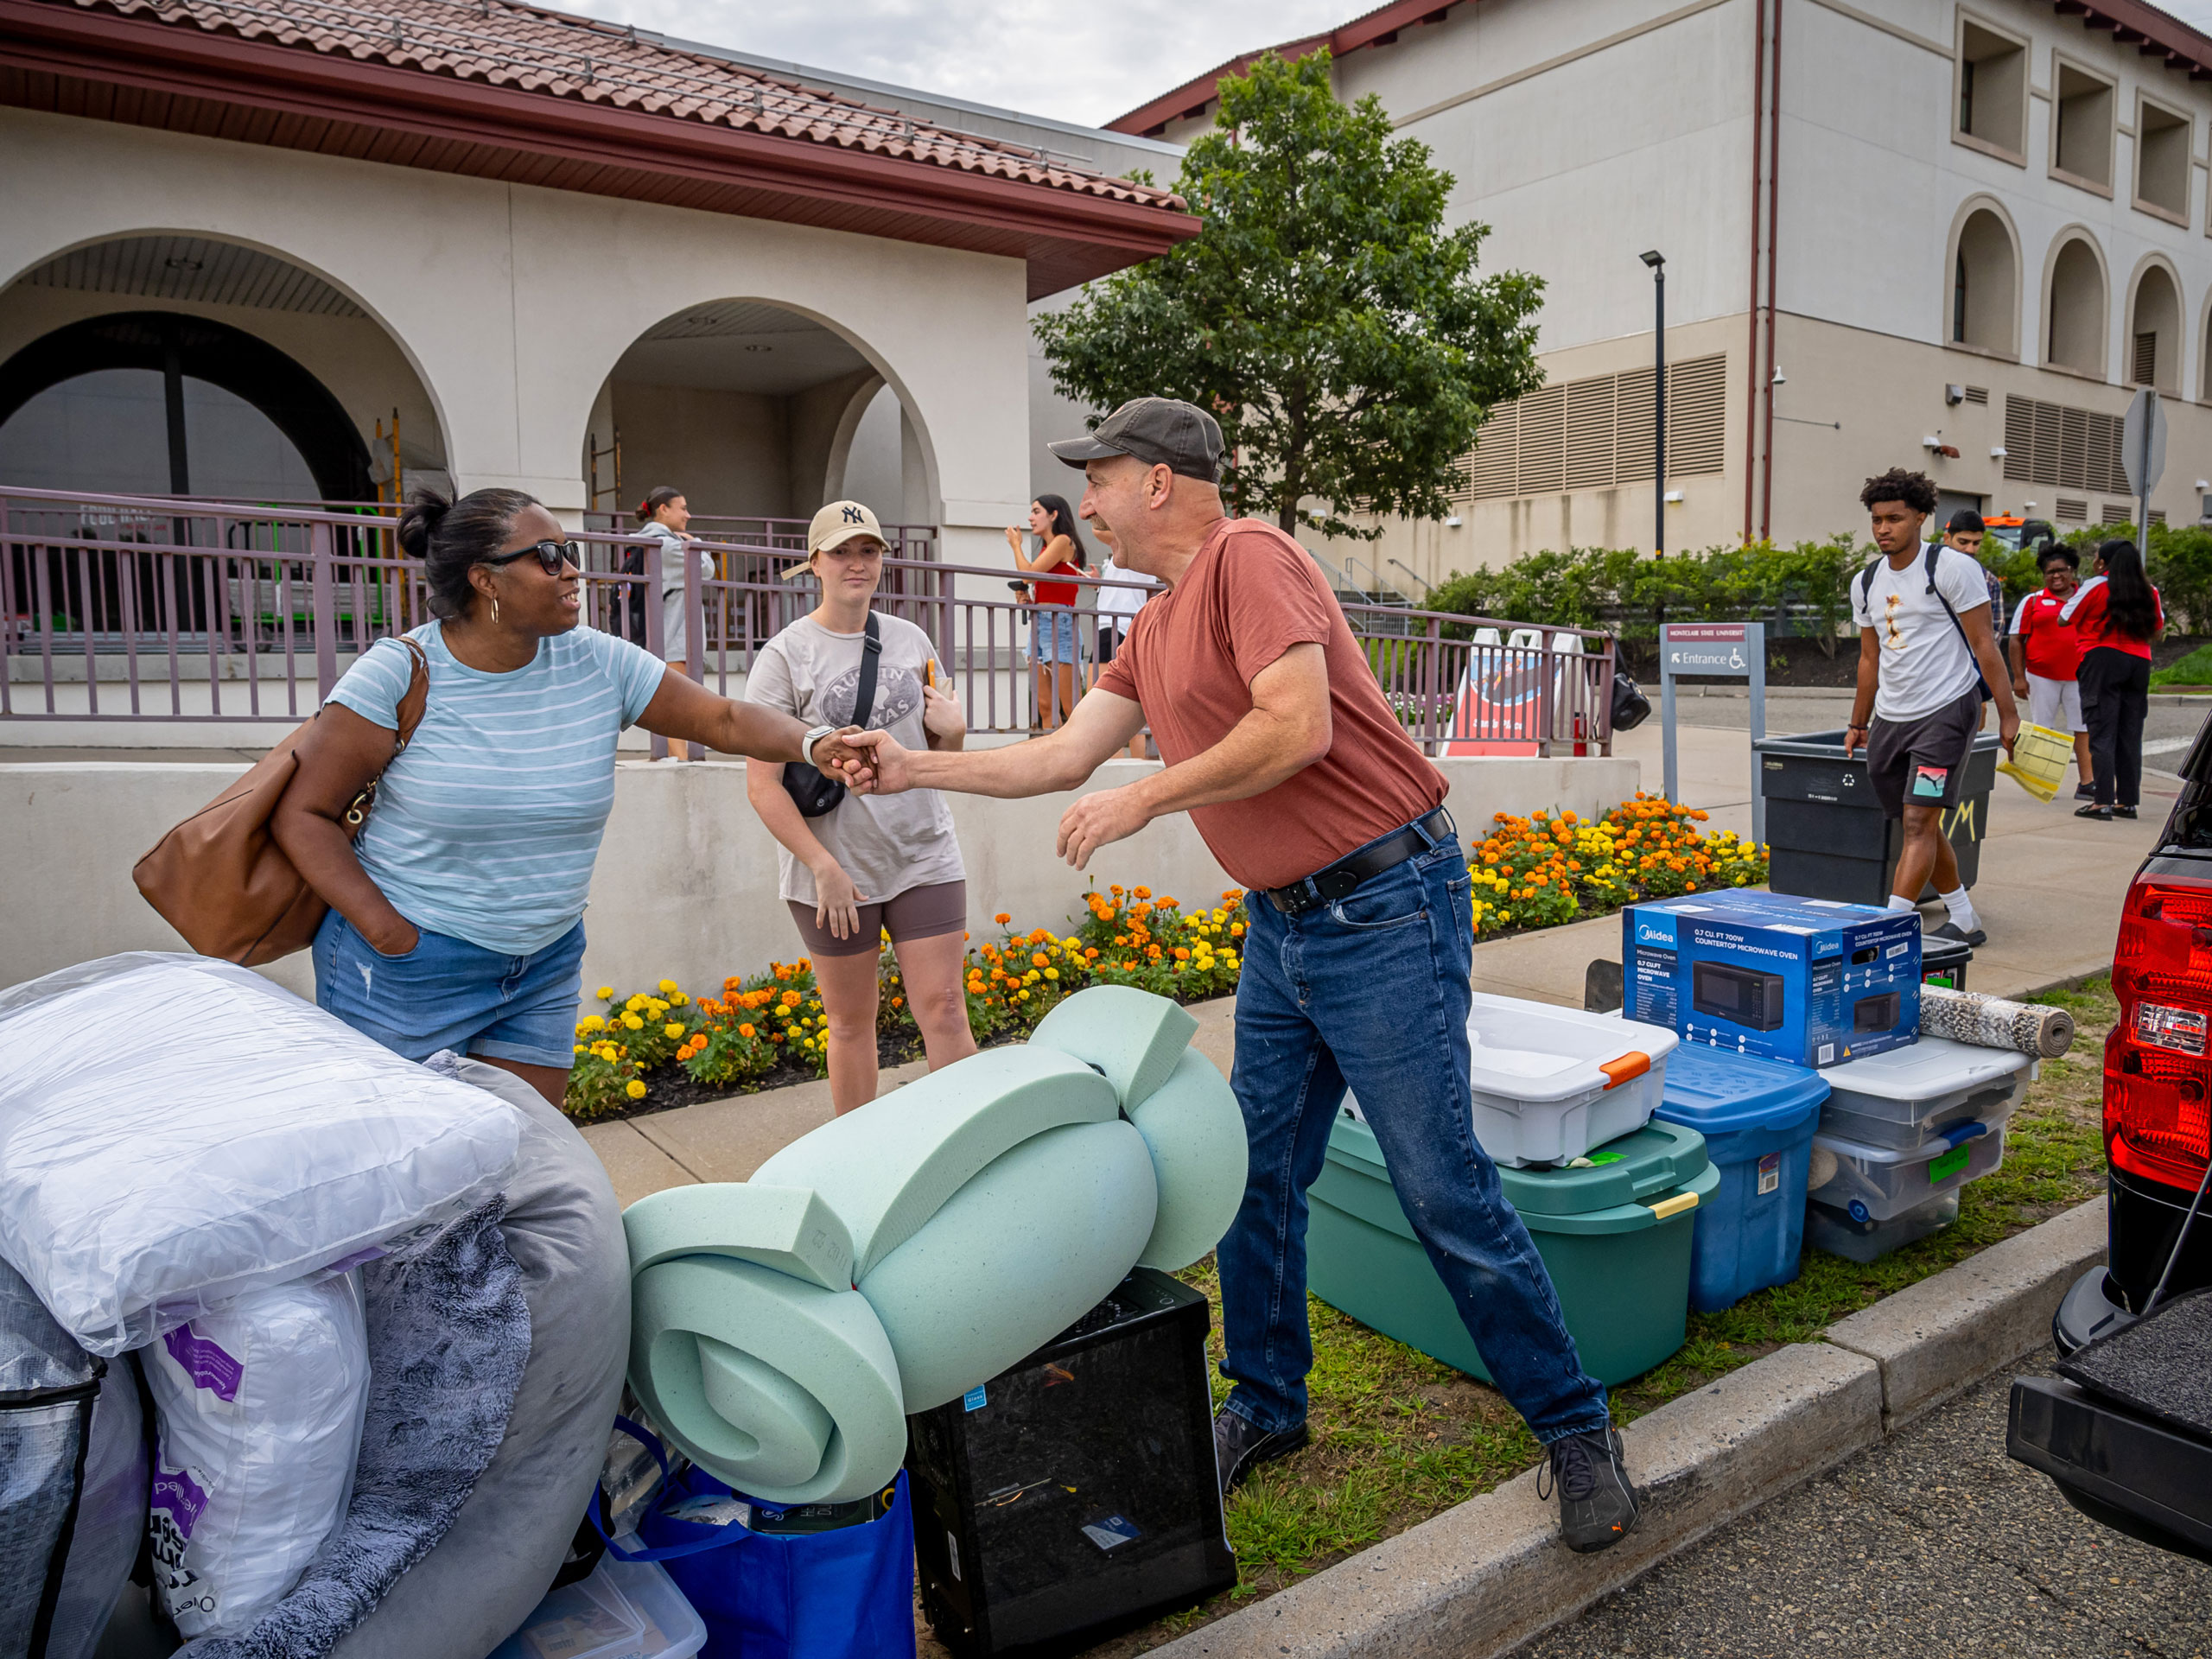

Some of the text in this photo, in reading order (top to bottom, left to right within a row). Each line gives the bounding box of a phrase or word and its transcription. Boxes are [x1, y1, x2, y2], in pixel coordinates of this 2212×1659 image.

[842, 505, 865, 524] NY
[1682, 652, 1727, 664] Entrance
[1639, 925, 1674, 943] Midea
[1726, 934, 1744, 943] 700W
[1694, 937, 1798, 960] COUNTERTOP MICROWAVE OVEN
[1816, 941, 1839, 954] Midea
[1637, 967, 1670, 978] MICROWAVE
